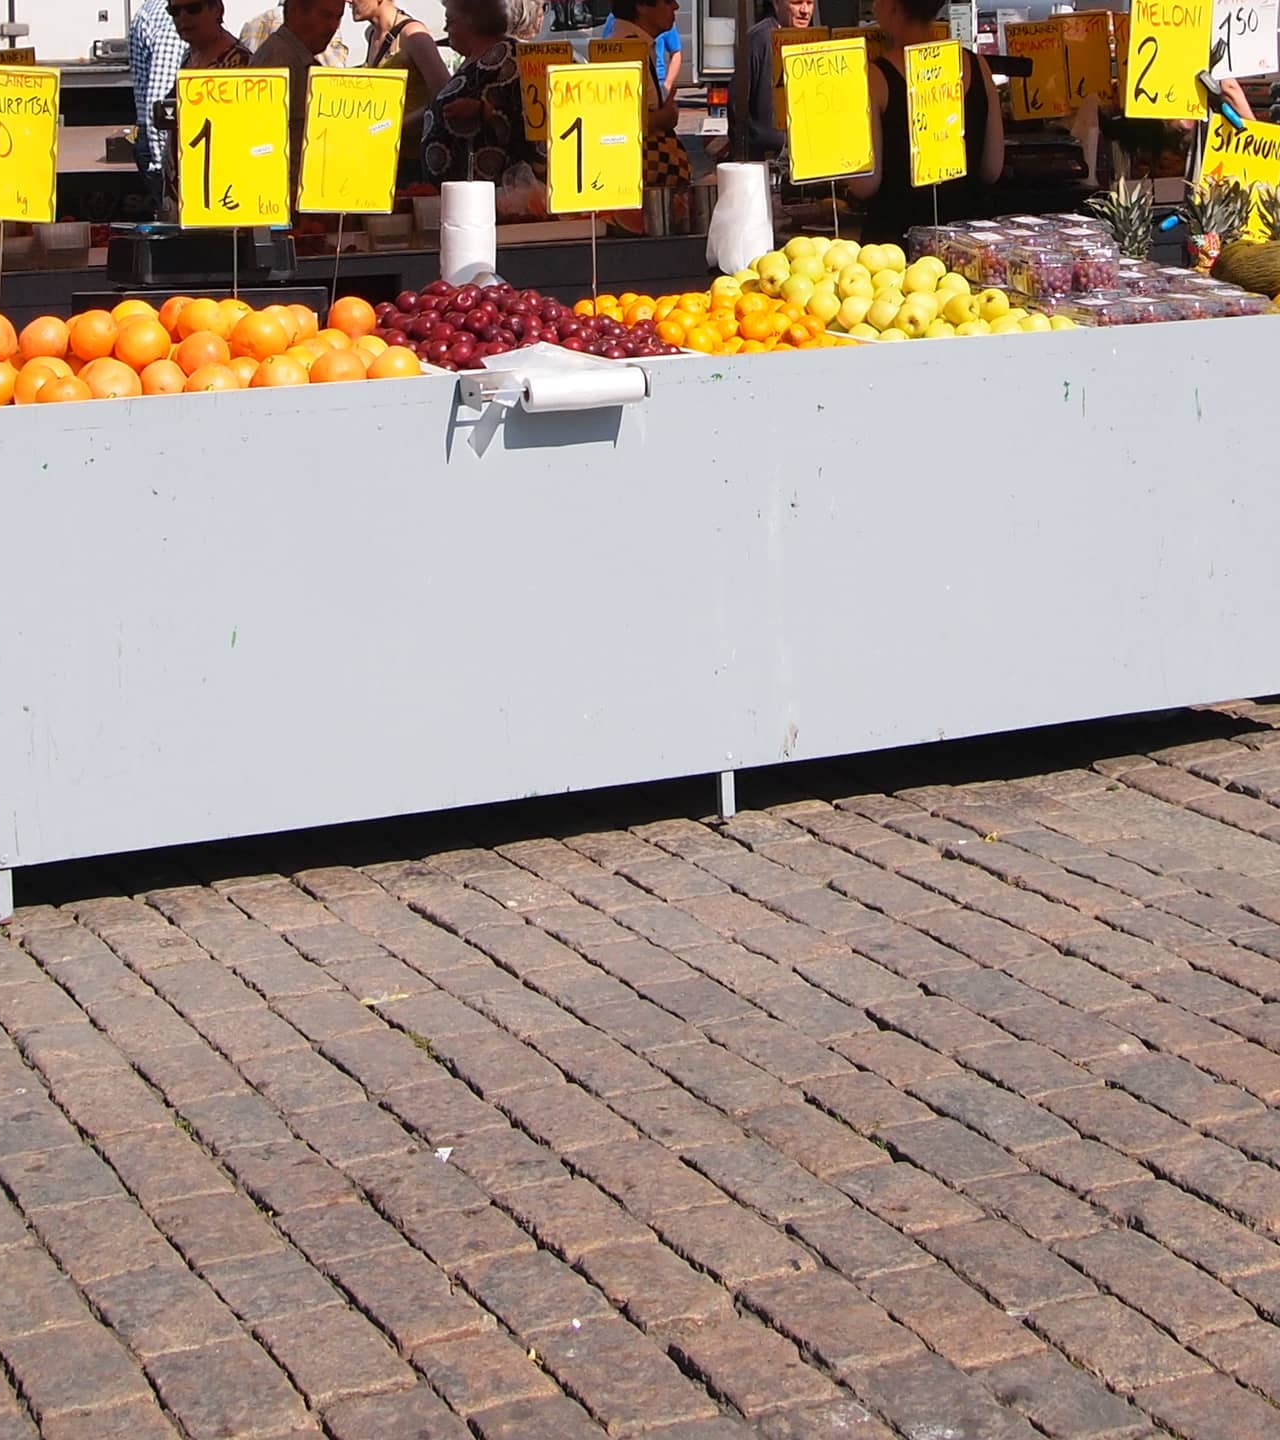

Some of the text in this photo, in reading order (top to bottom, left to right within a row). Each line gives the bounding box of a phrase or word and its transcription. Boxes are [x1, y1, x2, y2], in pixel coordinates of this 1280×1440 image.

[1136, 0, 1203, 27] MELONI
[792, 54, 853, 80] OMENA
[1134, 36, 1159, 105] 2
[185, 77, 273, 106] GREIPPI
[553, 79, 635, 108] SATSUMA
[317, 93, 387, 121] LUUMU
[188, 117, 212, 210] 1
[559, 117, 583, 194] 1
